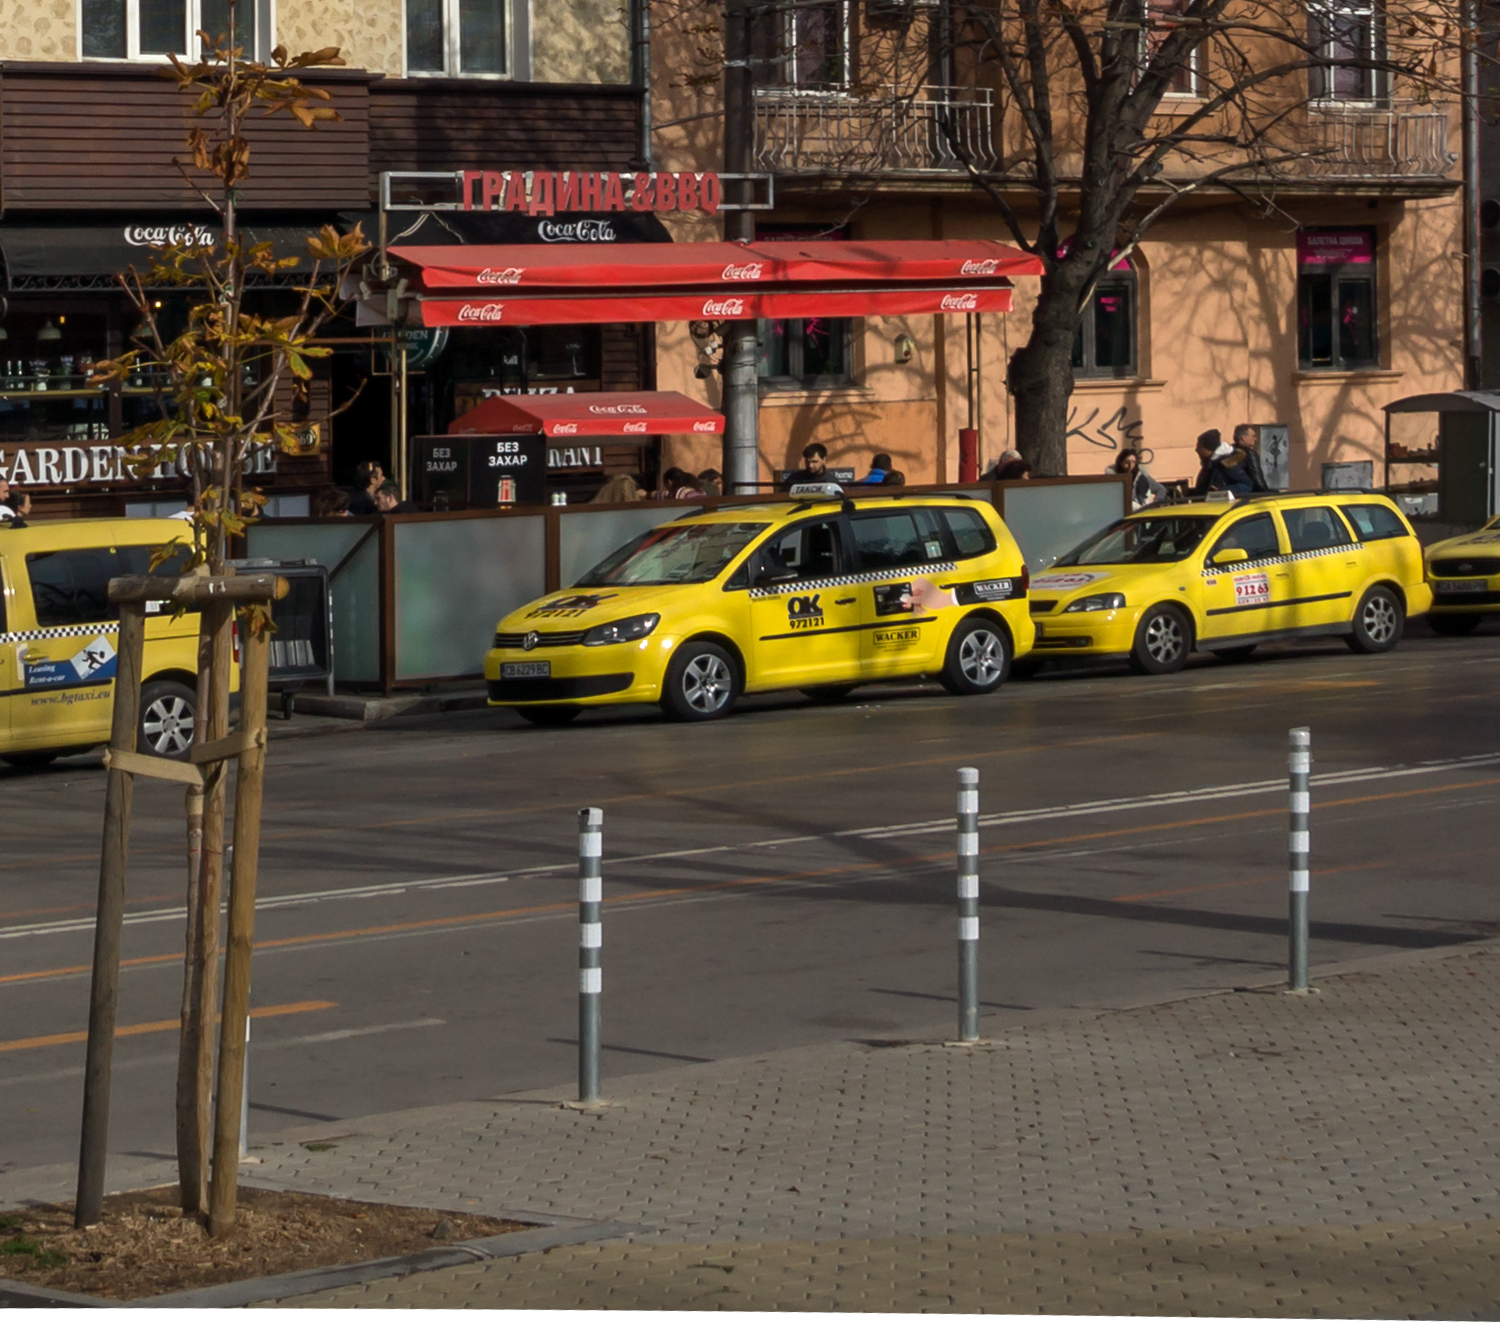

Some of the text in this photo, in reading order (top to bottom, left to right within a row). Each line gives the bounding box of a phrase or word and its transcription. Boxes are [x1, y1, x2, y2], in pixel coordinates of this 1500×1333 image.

[463, 171, 624, 217] ГРАДИНА
[432, 447, 450, 458] БЕЗ
[496, 442, 518, 453] БЕЗ
[426, 461, 457, 472] ЗАХАР
[488, 454, 528, 467] ЗАХАР
[976, 582, 1011, 594] WACKER
[790, 617, 824, 630] 972121
[876, 630, 918, 642] WACKER
[30, 689, 111, 706] www.bgtaxi.eu
